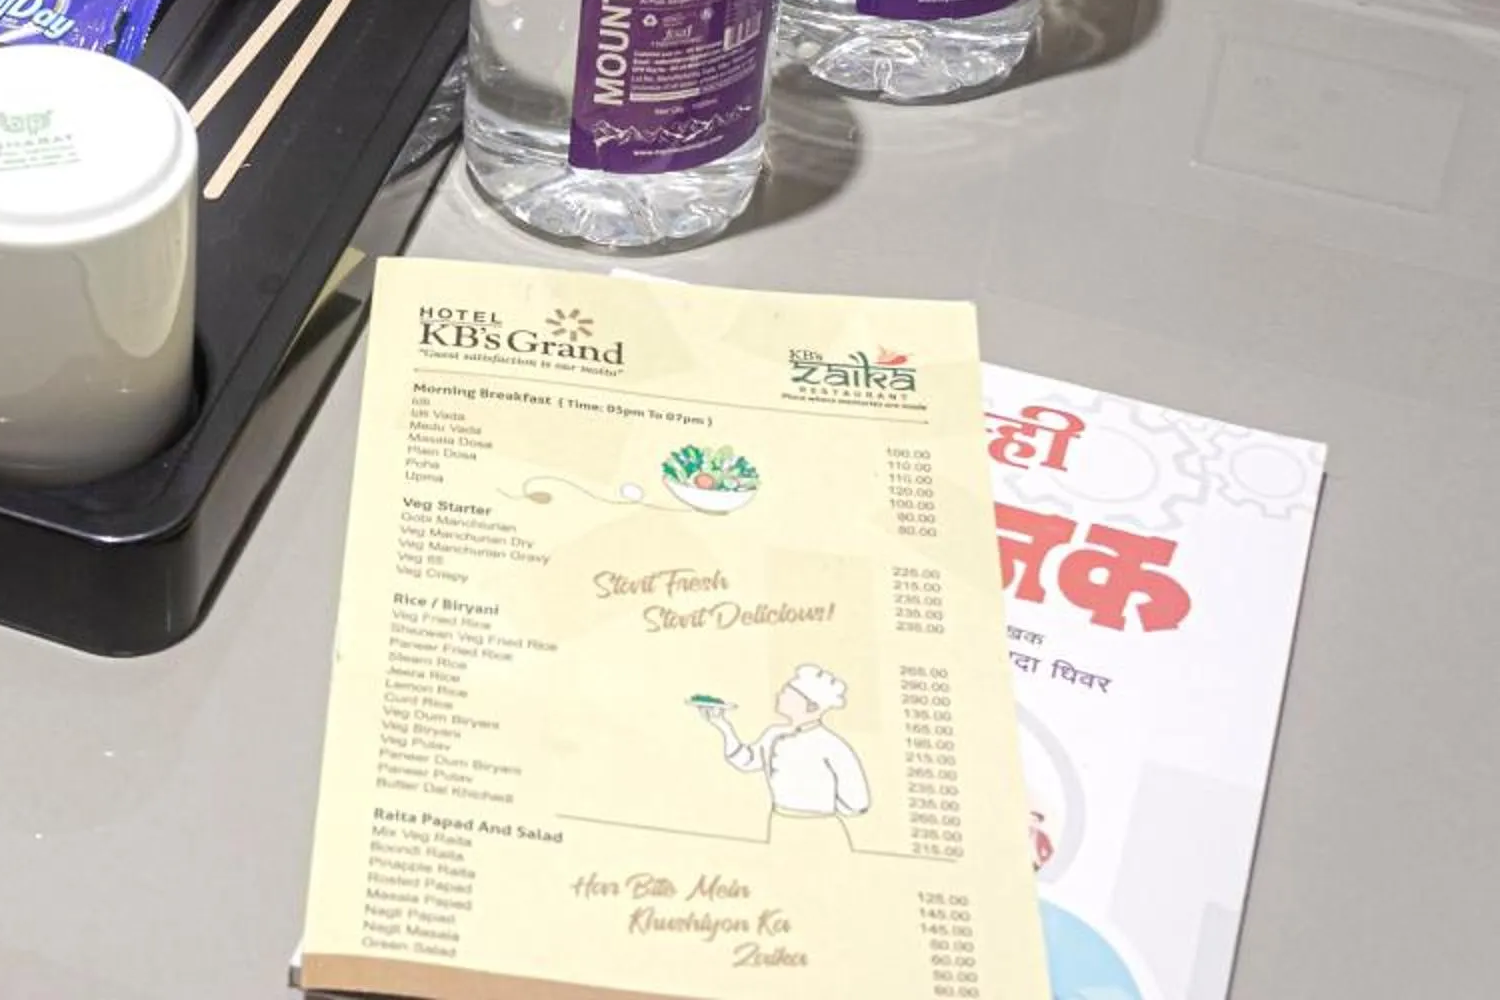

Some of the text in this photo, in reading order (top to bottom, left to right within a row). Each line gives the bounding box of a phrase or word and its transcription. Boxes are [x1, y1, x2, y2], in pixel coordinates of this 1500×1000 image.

[420, 306, 502, 324] HOTEL
[420, 323, 624, 365] KB's Grand
[413, 383, 476, 399] Morning
[479, 388, 552, 405] Breakfast
[403, 496, 492, 516] Veg Starter
[655, 568, 729, 597] Fresh
[393, 592, 427, 607] Rice
[442, 598, 499, 616] Biryani
[1051, 660, 1112, 693] धिवर
[373, 807, 564, 843] Raita Papad And Salad
